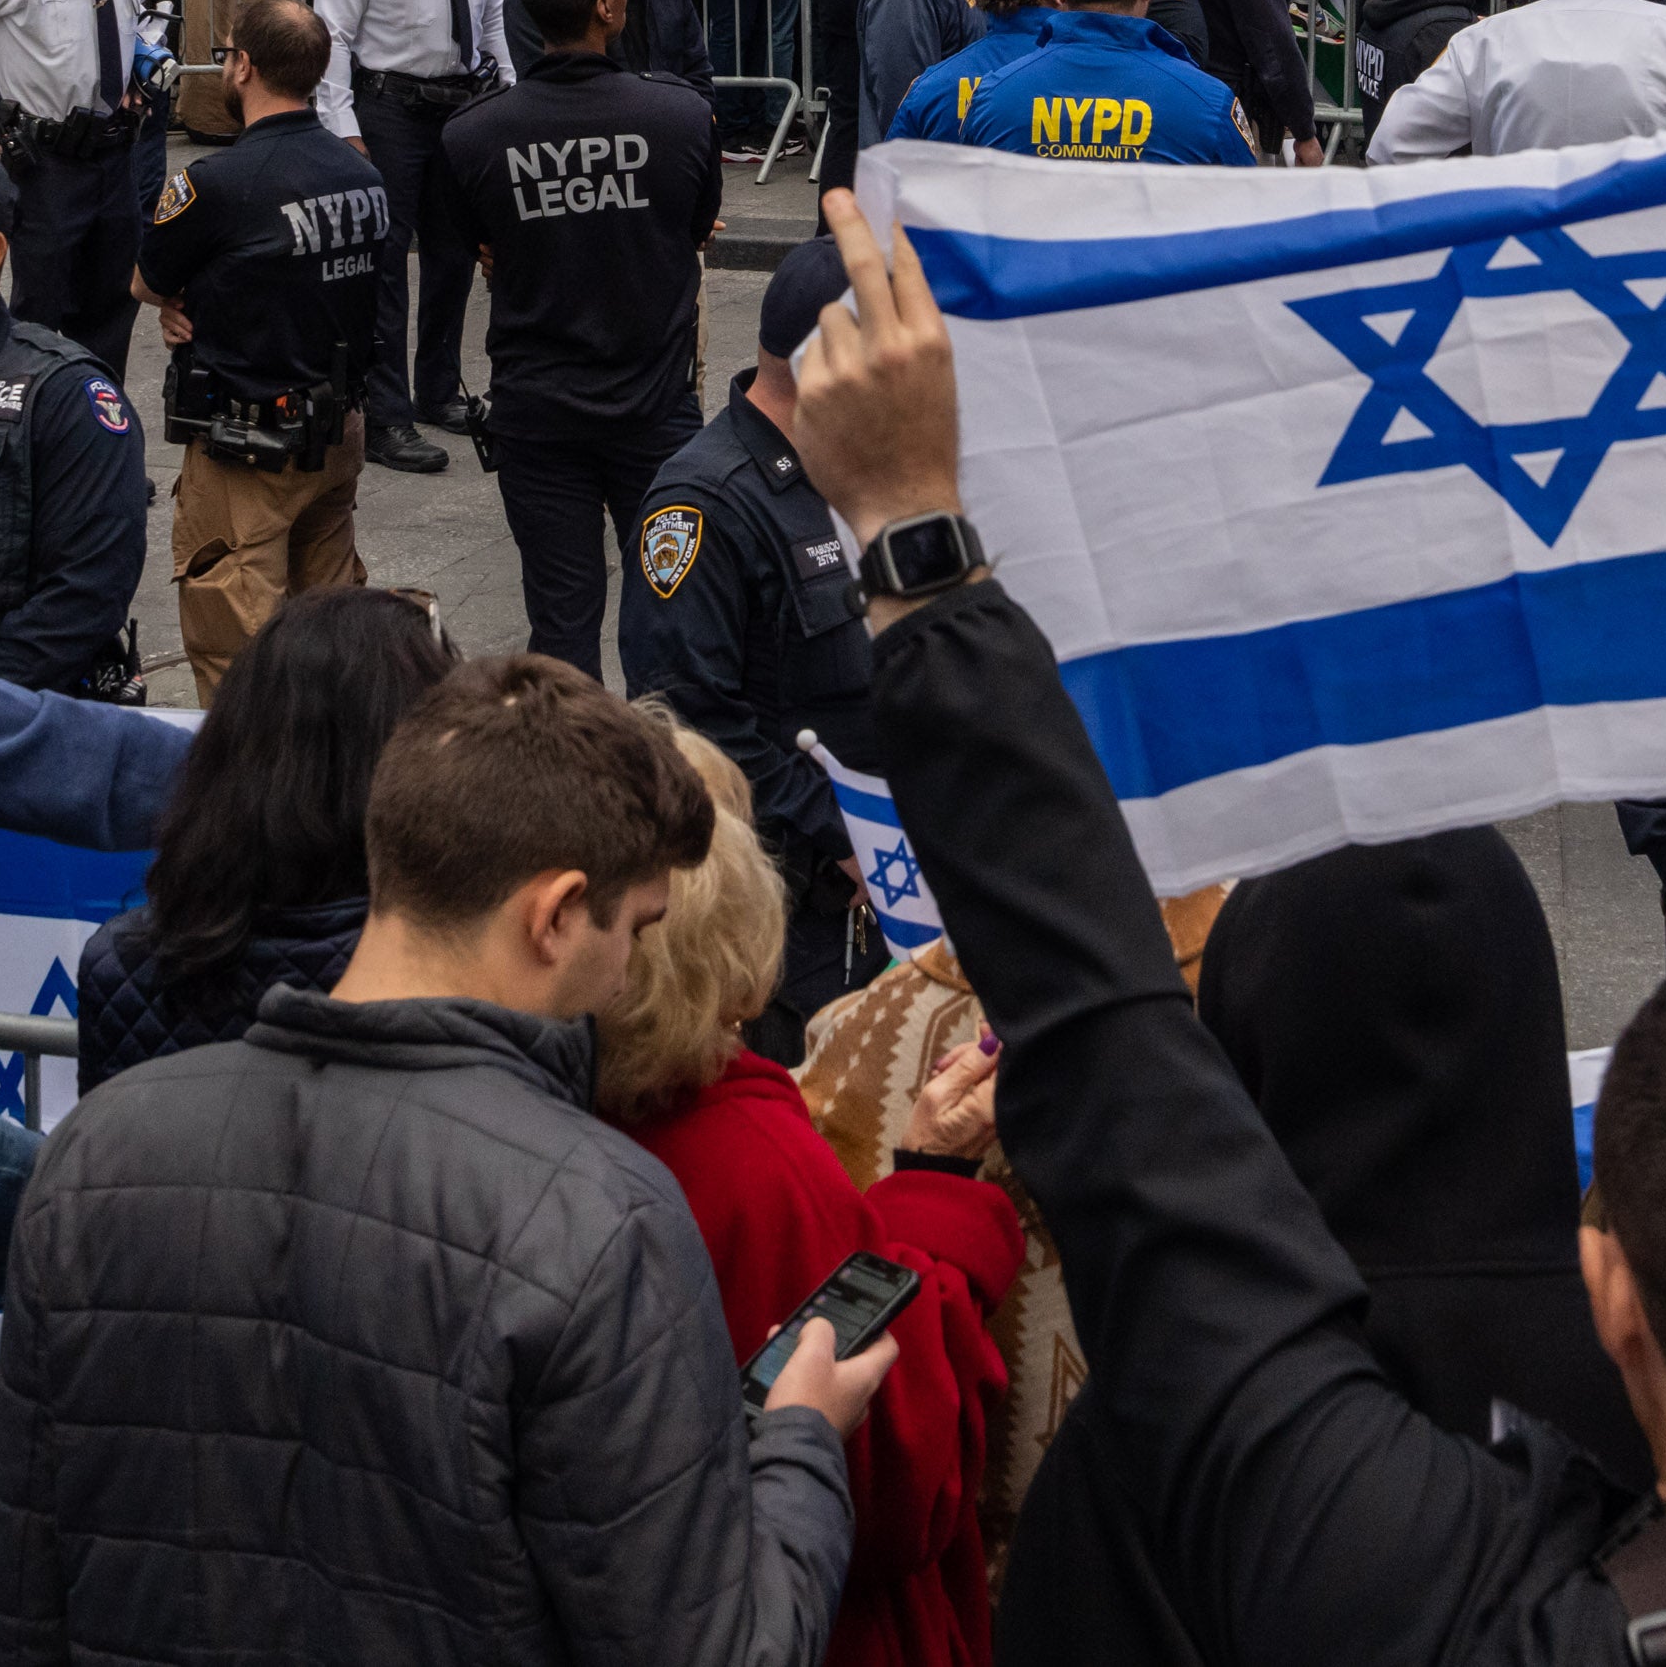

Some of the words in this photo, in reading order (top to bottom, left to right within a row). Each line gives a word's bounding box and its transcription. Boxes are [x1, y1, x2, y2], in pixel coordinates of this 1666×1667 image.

[1355, 37, 1385, 81] NYPD
[1357, 71, 1379, 100] POLICE
[1031, 96, 1153, 146] NYPD
[506, 134, 649, 184] NYPD
[1037, 144, 1143, 160] COMMUNITY
[513, 173, 649, 221] LEGAL
[281, 186, 390, 256] NYPD
[321, 252, 375, 282] LEGAL
